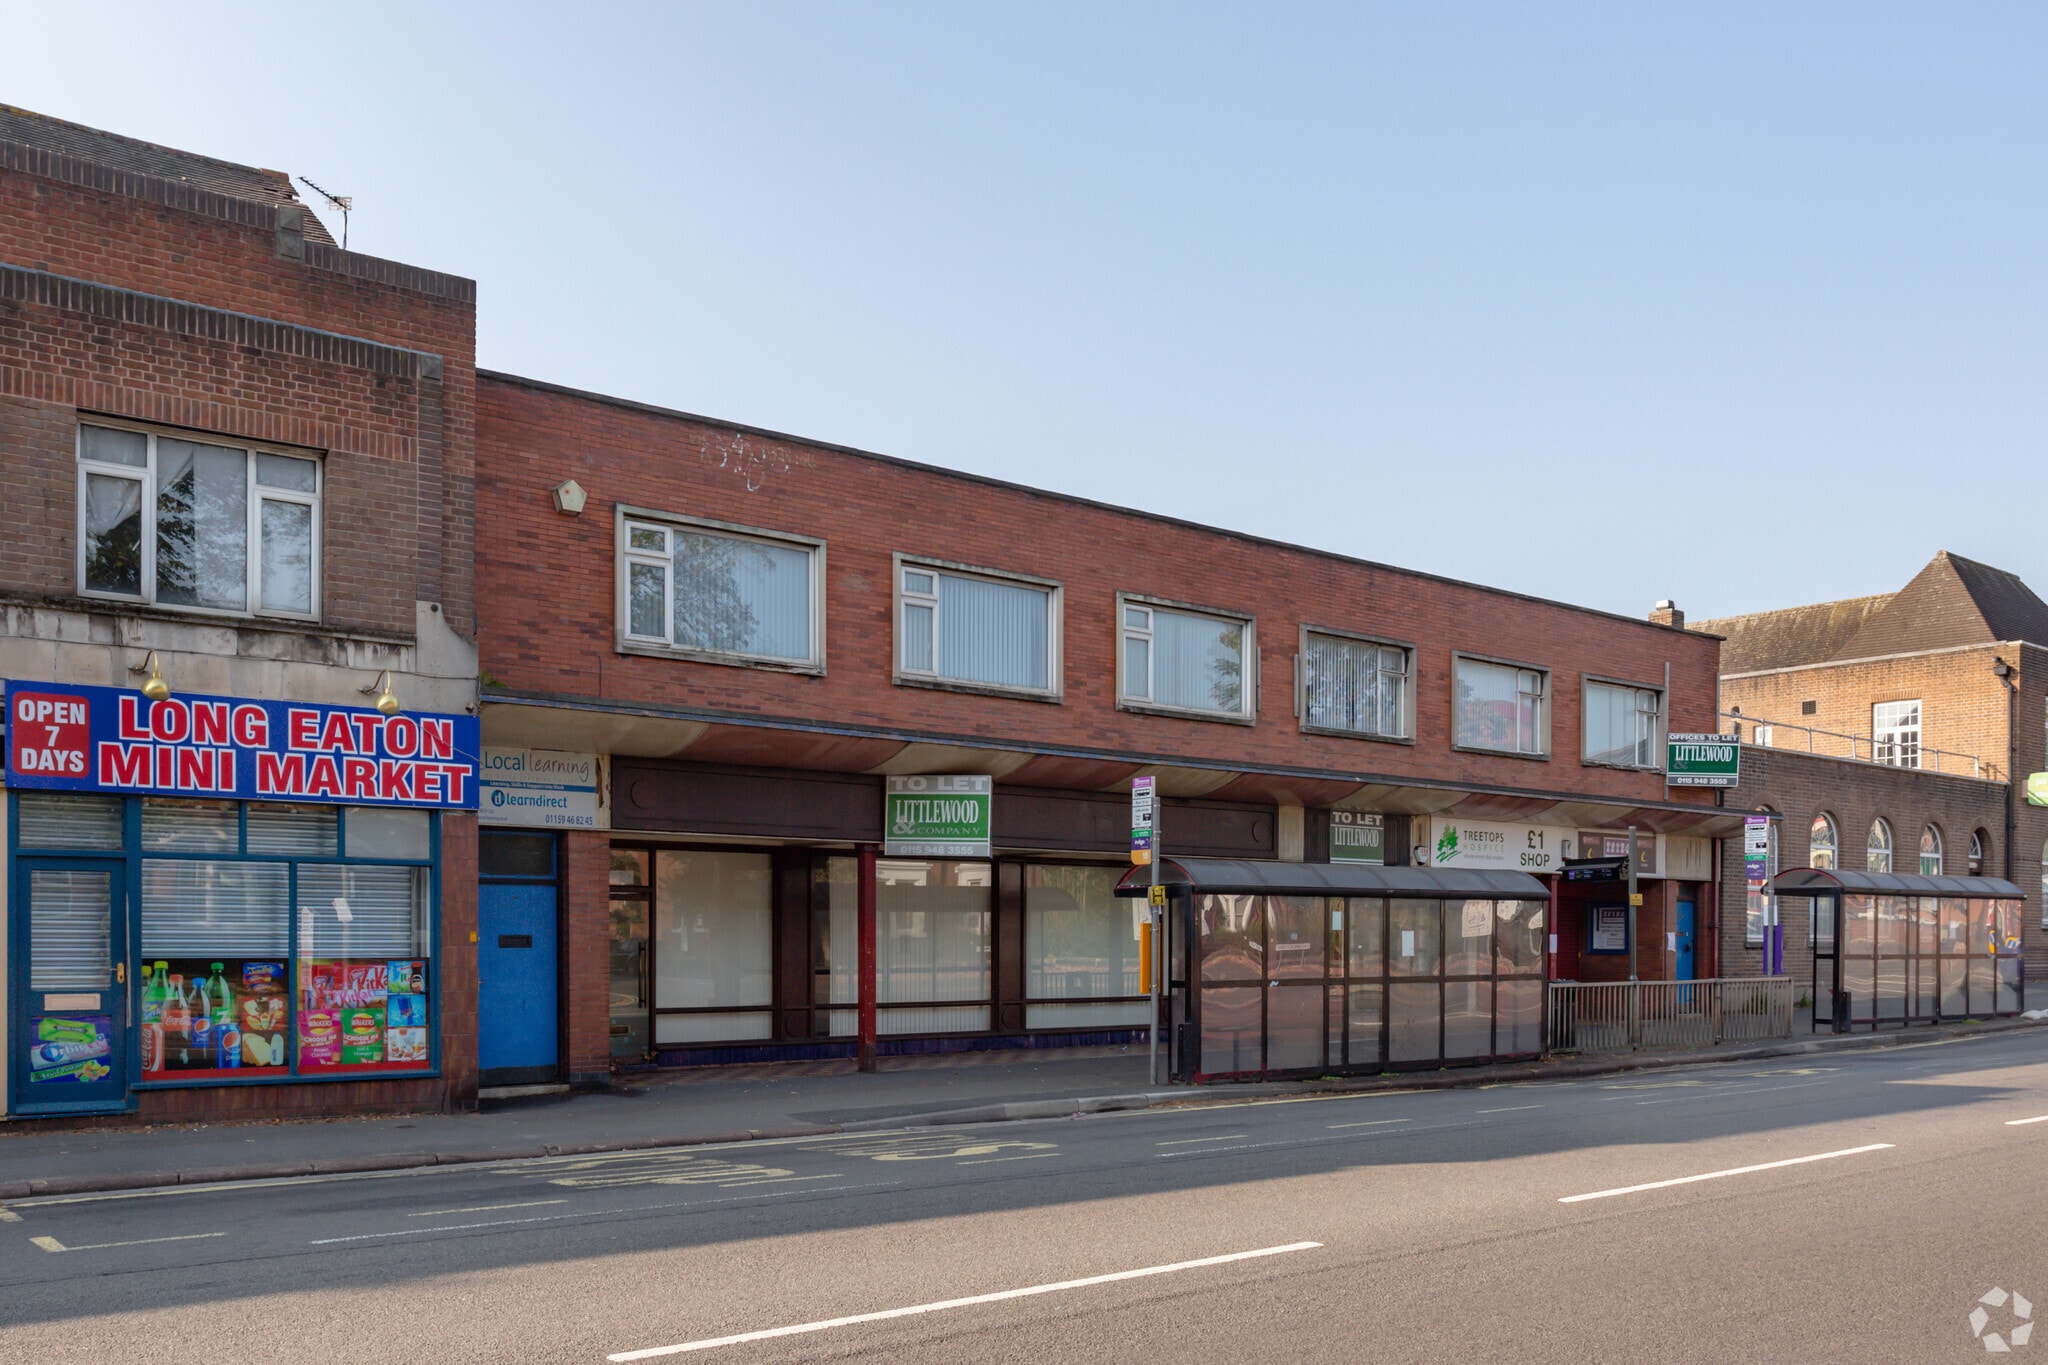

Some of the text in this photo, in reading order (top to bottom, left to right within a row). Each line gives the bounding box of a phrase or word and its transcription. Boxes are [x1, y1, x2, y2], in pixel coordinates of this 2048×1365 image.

[18, 698, 86, 725] OPEN
[45, 726, 61, 747] 7
[118, 696, 454, 760] LONG EATON
[21, 748, 84, 773] DAYS
[1675, 745, 1733, 762] LITTLEWOOD
[98, 741, 472, 803] MINI MARKET
[485, 751, 525, 771] Local
[529, 753, 589, 782] learning
[891, 777, 988, 790] TO LET
[506, 792, 568, 808] learndirect
[545, 814, 566, 824] 01159
[566, 815, 575, 825] 46
[584, 816, 593, 825] 45
[896, 800, 979, 823] LITTLEWOOD
[1333, 811, 1382, 825] TO LET
[893, 817, 980, 835] & COMPANY
[1335, 827, 1379, 847] LITTLEWOOD
[1464, 830, 1504, 842] TREETOPS
[1527, 830, 1544, 849] £1
[901, 846, 973, 855] 0115 948 3555
[1463, 843, 1504, 852] HOSPICE
[1520, 853, 1550, 866] SHOP
